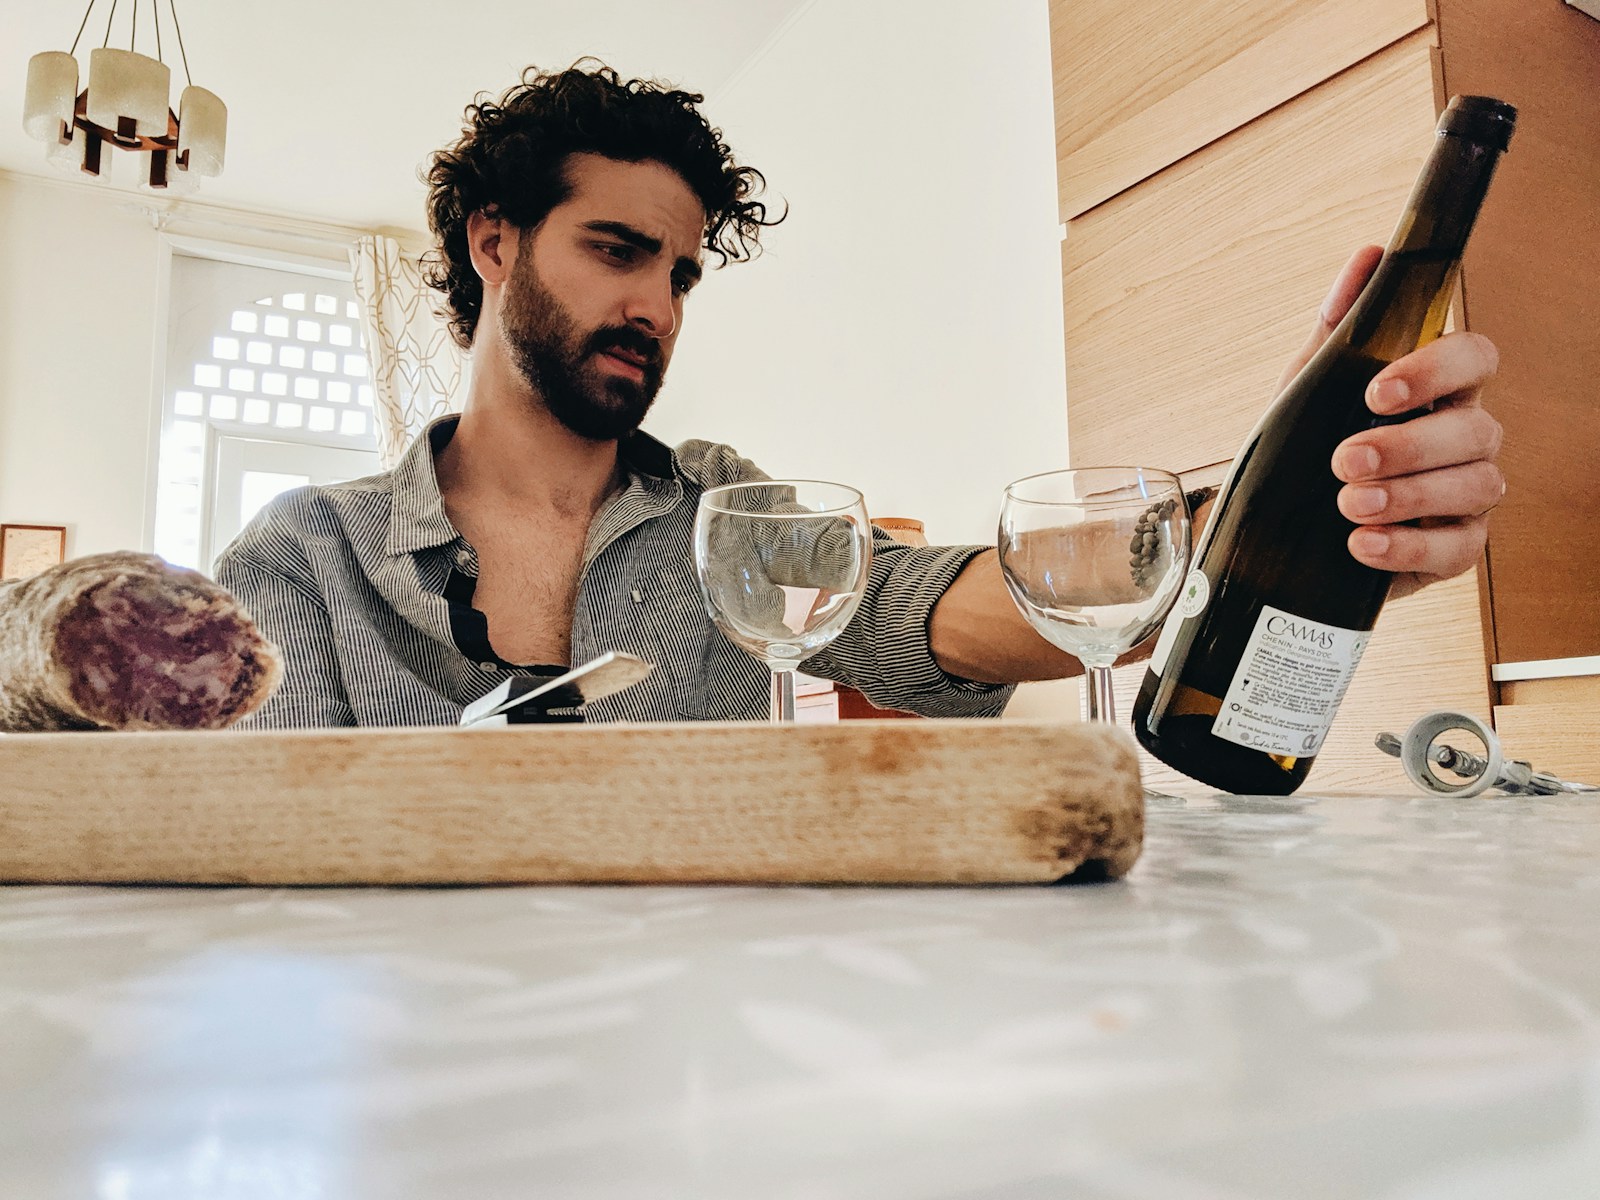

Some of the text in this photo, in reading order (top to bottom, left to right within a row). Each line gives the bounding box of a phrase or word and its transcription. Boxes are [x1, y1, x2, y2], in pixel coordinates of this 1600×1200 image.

[1261, 633, 1293, 648] CHENIN
[1298, 645, 1316, 656] PAYS
[1267, 616, 1335, 649] CAMAS
